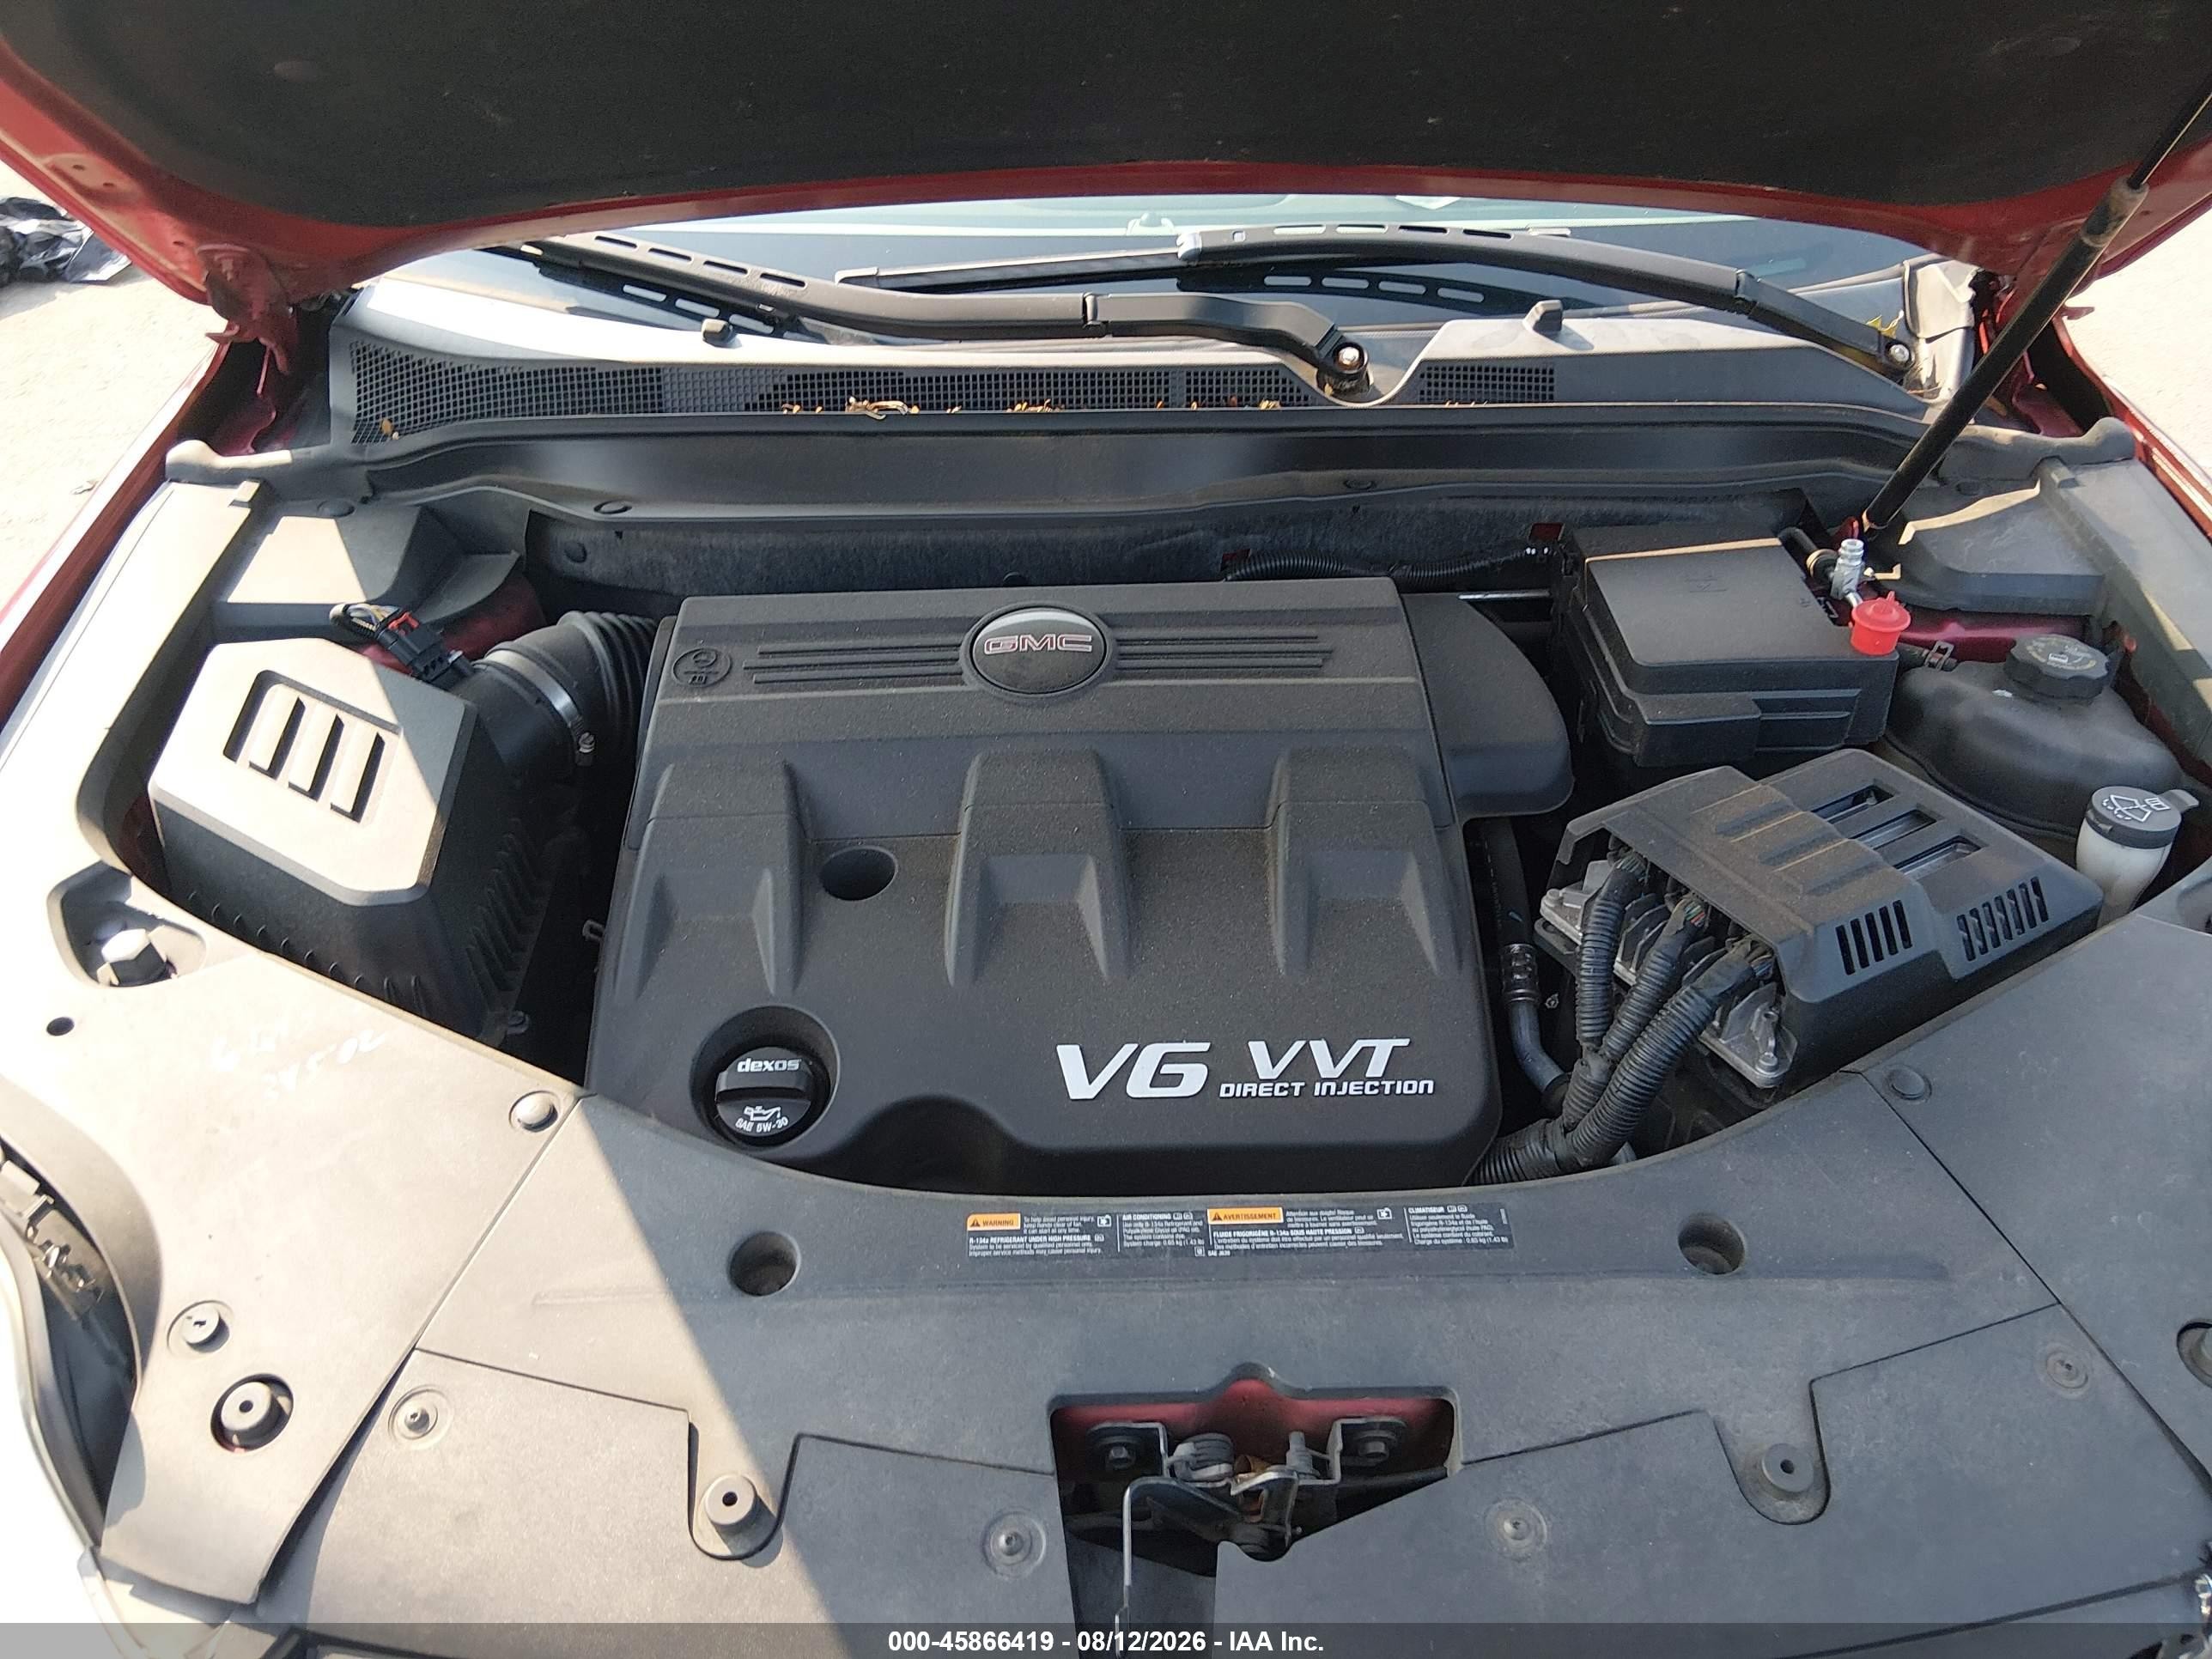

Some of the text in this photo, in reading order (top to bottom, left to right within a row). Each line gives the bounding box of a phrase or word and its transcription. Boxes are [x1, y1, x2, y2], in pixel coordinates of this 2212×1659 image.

[984, 633, 1092, 654] GMC
[737, 1058, 799, 1073] dexos
[1056, 1038, 1411, 1100] V6 VVT
[1219, 1079, 1435, 1098] DIRECT INJECTION
[735, 1116, 789, 1133] SAE 5W-30
